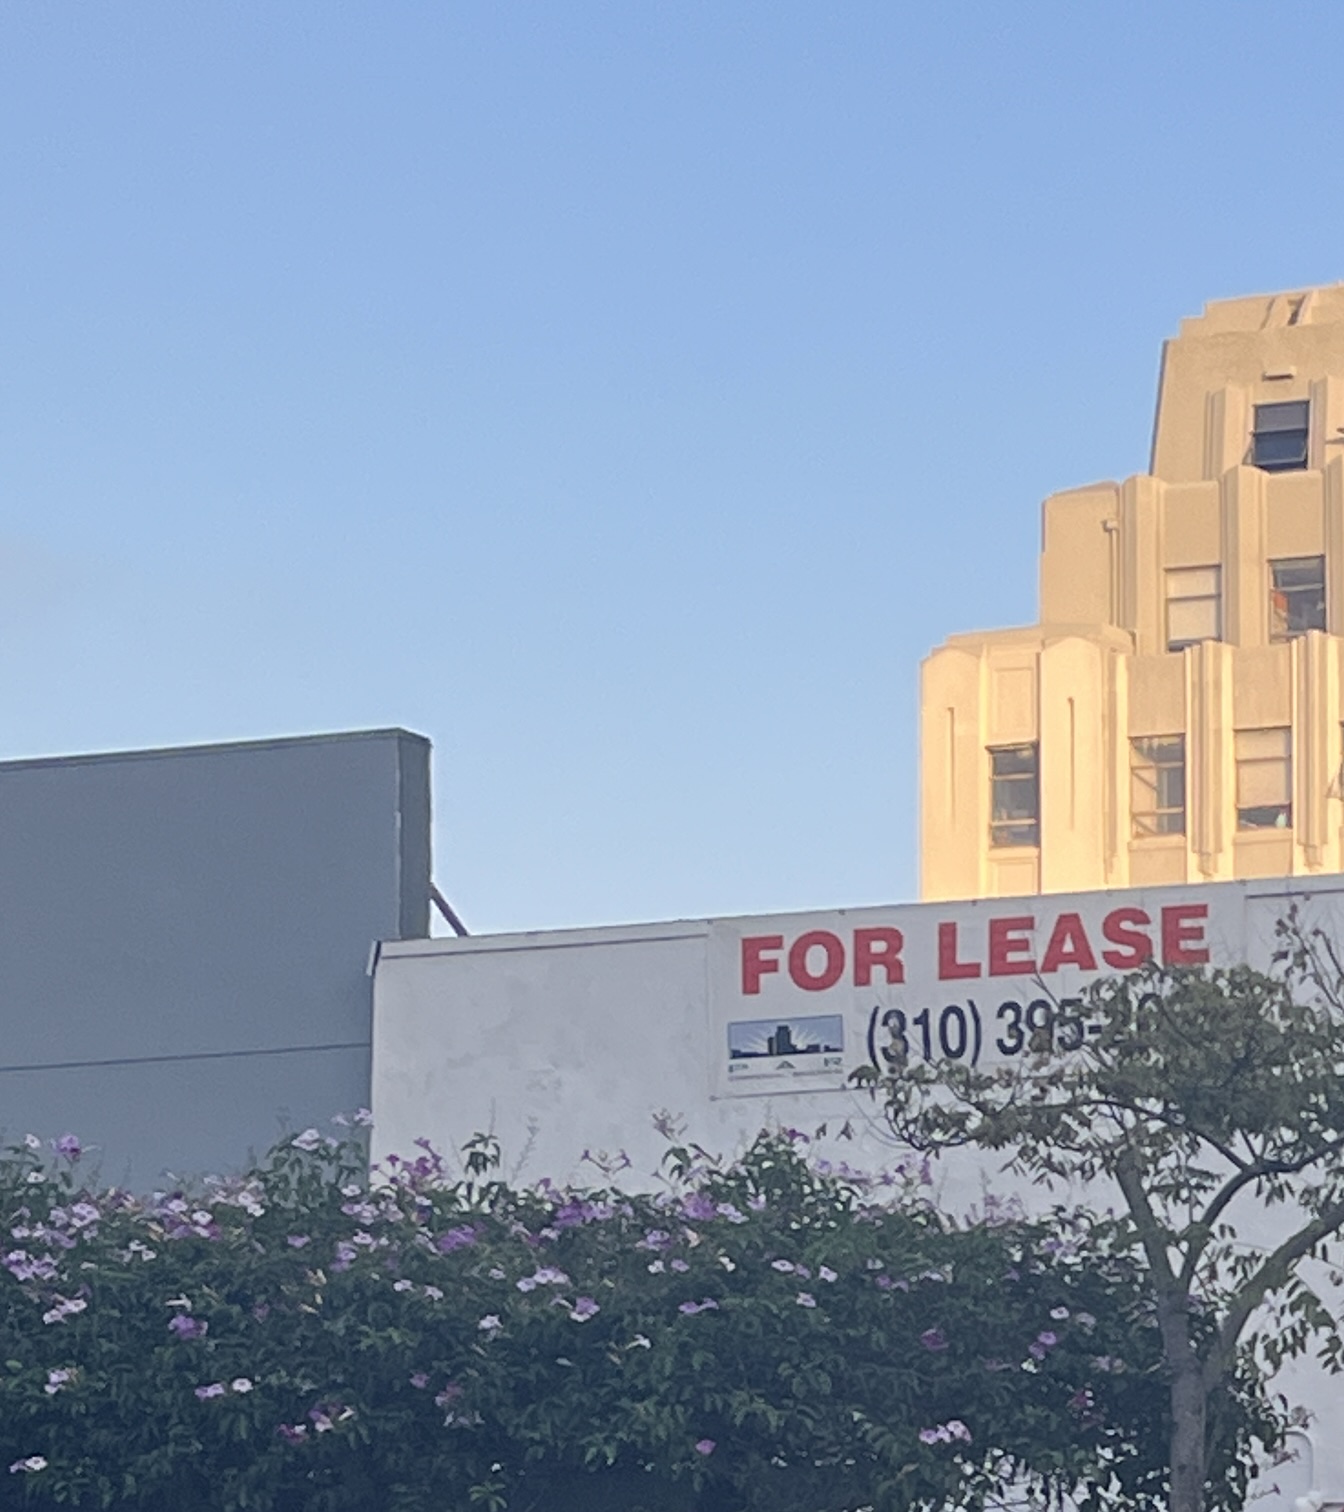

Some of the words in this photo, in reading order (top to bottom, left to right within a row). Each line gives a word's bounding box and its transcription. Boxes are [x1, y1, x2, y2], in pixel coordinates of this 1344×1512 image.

[742, 927, 905, 995] FOR
[938, 904, 1210, 981] LEASE
[868, 998, 981, 1072] (310)
